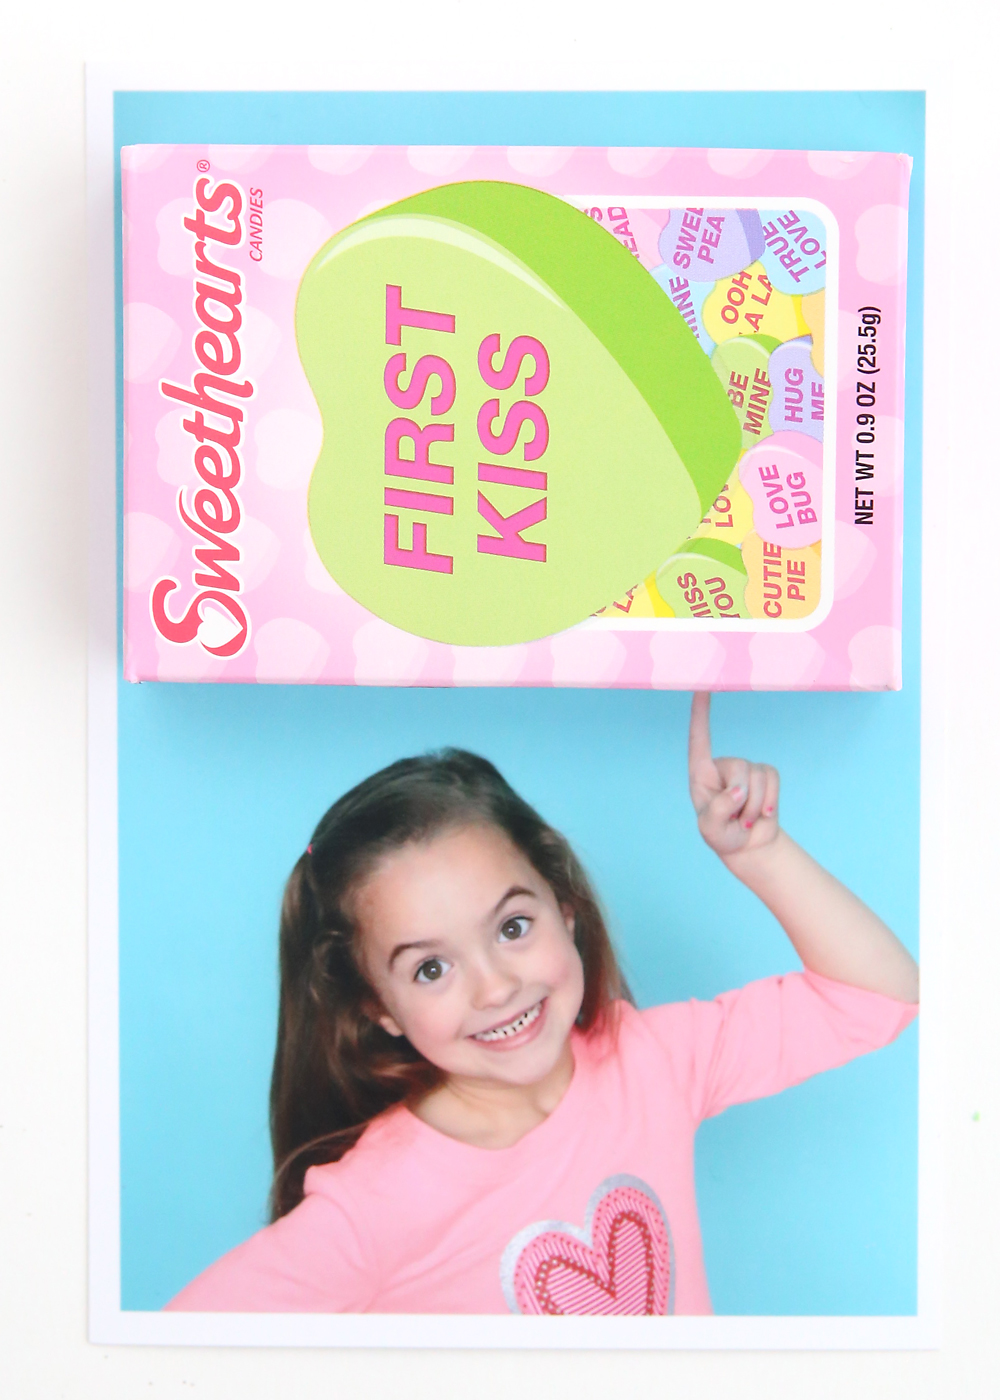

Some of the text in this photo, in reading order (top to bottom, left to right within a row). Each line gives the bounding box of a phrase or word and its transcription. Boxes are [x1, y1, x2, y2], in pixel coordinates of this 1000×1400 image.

[250, 187, 263, 261] CANDIES
[697, 216, 725, 264] PEA
[763, 222, 809, 283] TRUE
[777, 210, 826, 269] LOVE
[721, 271, 752, 324] OOH
[152, 177, 253, 658] Sweethearts
[727, 371, 749, 408] BE
[743, 368, 771, 435] MINE
[784, 368, 803, 422] HUG
[855, 306, 881, 525] NET WT 0.9 OZ (25.5g)
[384, 284, 456, 575] FIRST
[477, 333, 550, 563] KISS
[758, 465, 794, 529] LOVE
[786, 472, 817, 524] BUG
[763, 542, 782, 618] CUTIE
[787, 560, 805, 601] PIE
